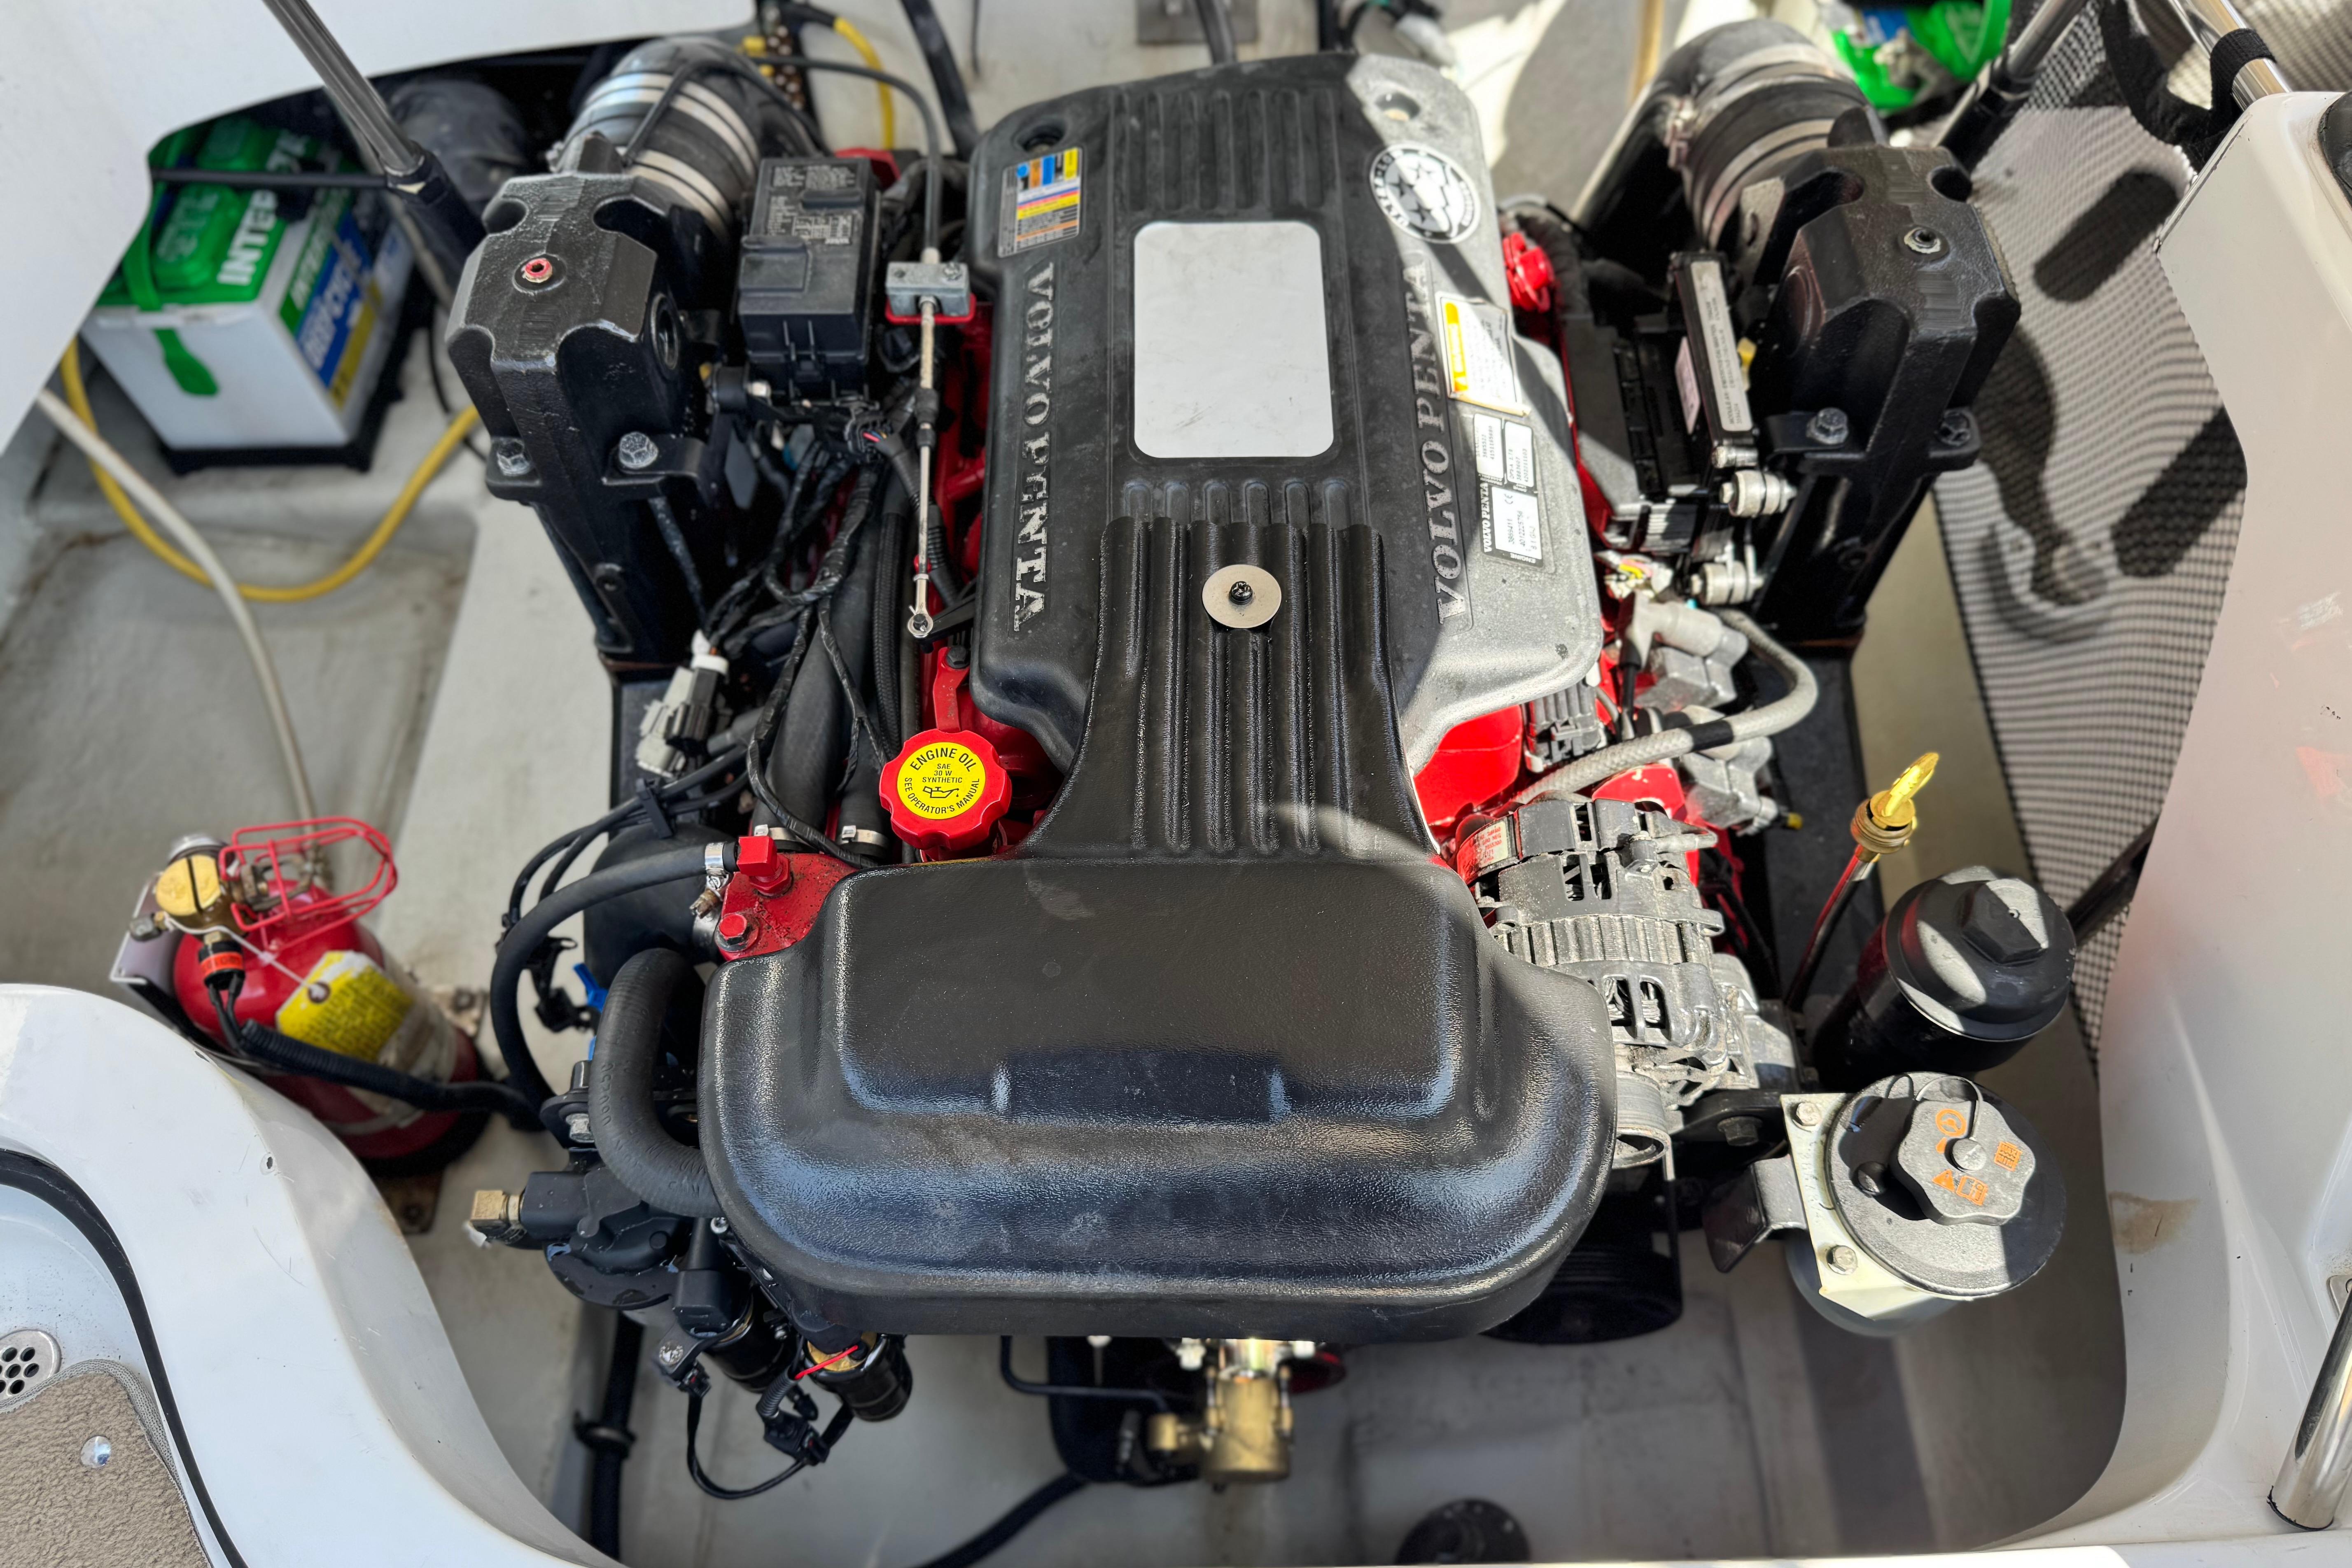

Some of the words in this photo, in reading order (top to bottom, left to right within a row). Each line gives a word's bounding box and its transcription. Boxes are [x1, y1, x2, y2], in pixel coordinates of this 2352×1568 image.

[1023, 262, 1054, 426] VOLVO
[1404, 261, 1444, 432] PENTA
[1480, 483, 1490, 519] PENTA
[1014, 432, 1051, 632] PENTA
[1421, 440, 1466, 624] VOLVO
[1482, 520, 1492, 552] VOLVO
[910, 747, 958, 771] ENGINE
[959, 752, 977, 772] OIL
[904, 777, 913, 792] SEE
[956, 778, 980, 809] MANUAL
[907, 792, 955, 814] OPERATOR'S
